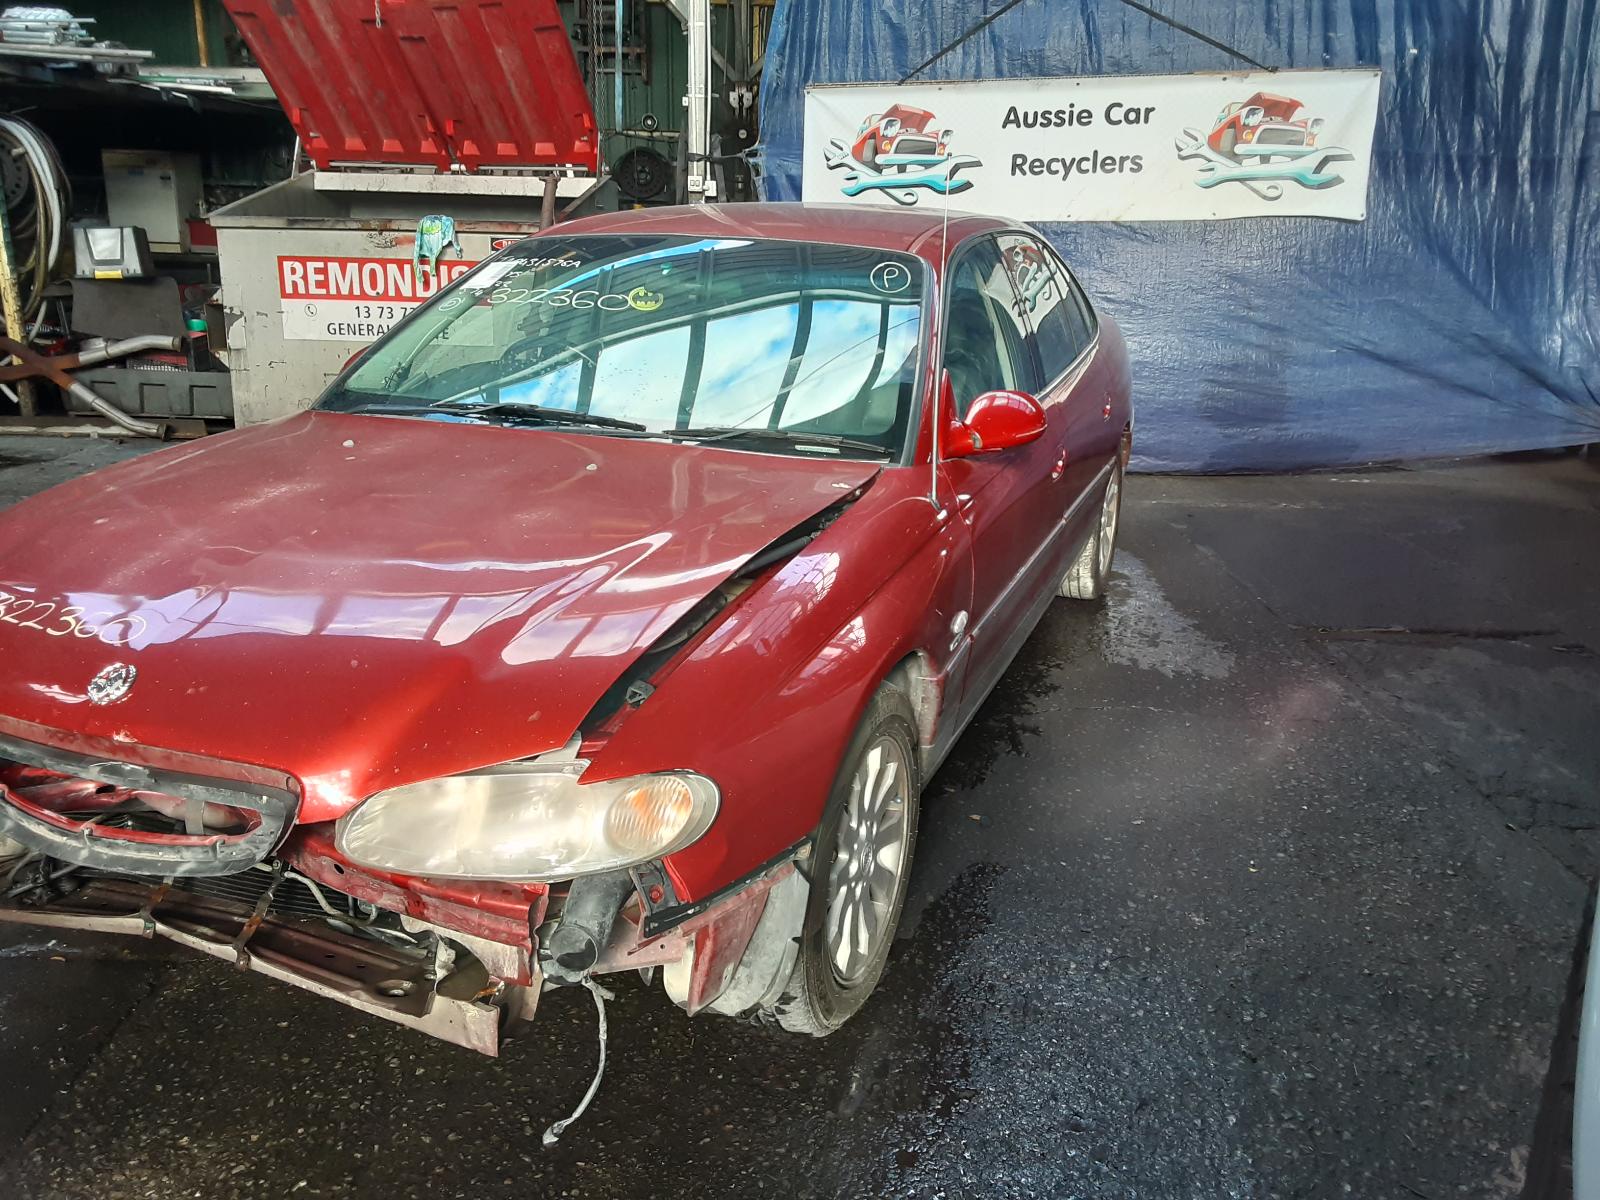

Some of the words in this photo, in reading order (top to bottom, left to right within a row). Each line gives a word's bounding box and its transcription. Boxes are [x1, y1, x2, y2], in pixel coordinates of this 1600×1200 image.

[1002, 103, 1093, 129] Aussie
[1104, 102, 1156, 126] Car
[1011, 150, 1143, 181] Recyclers
[355, 305, 371, 319] 13
[378, 306, 394, 320] 73
